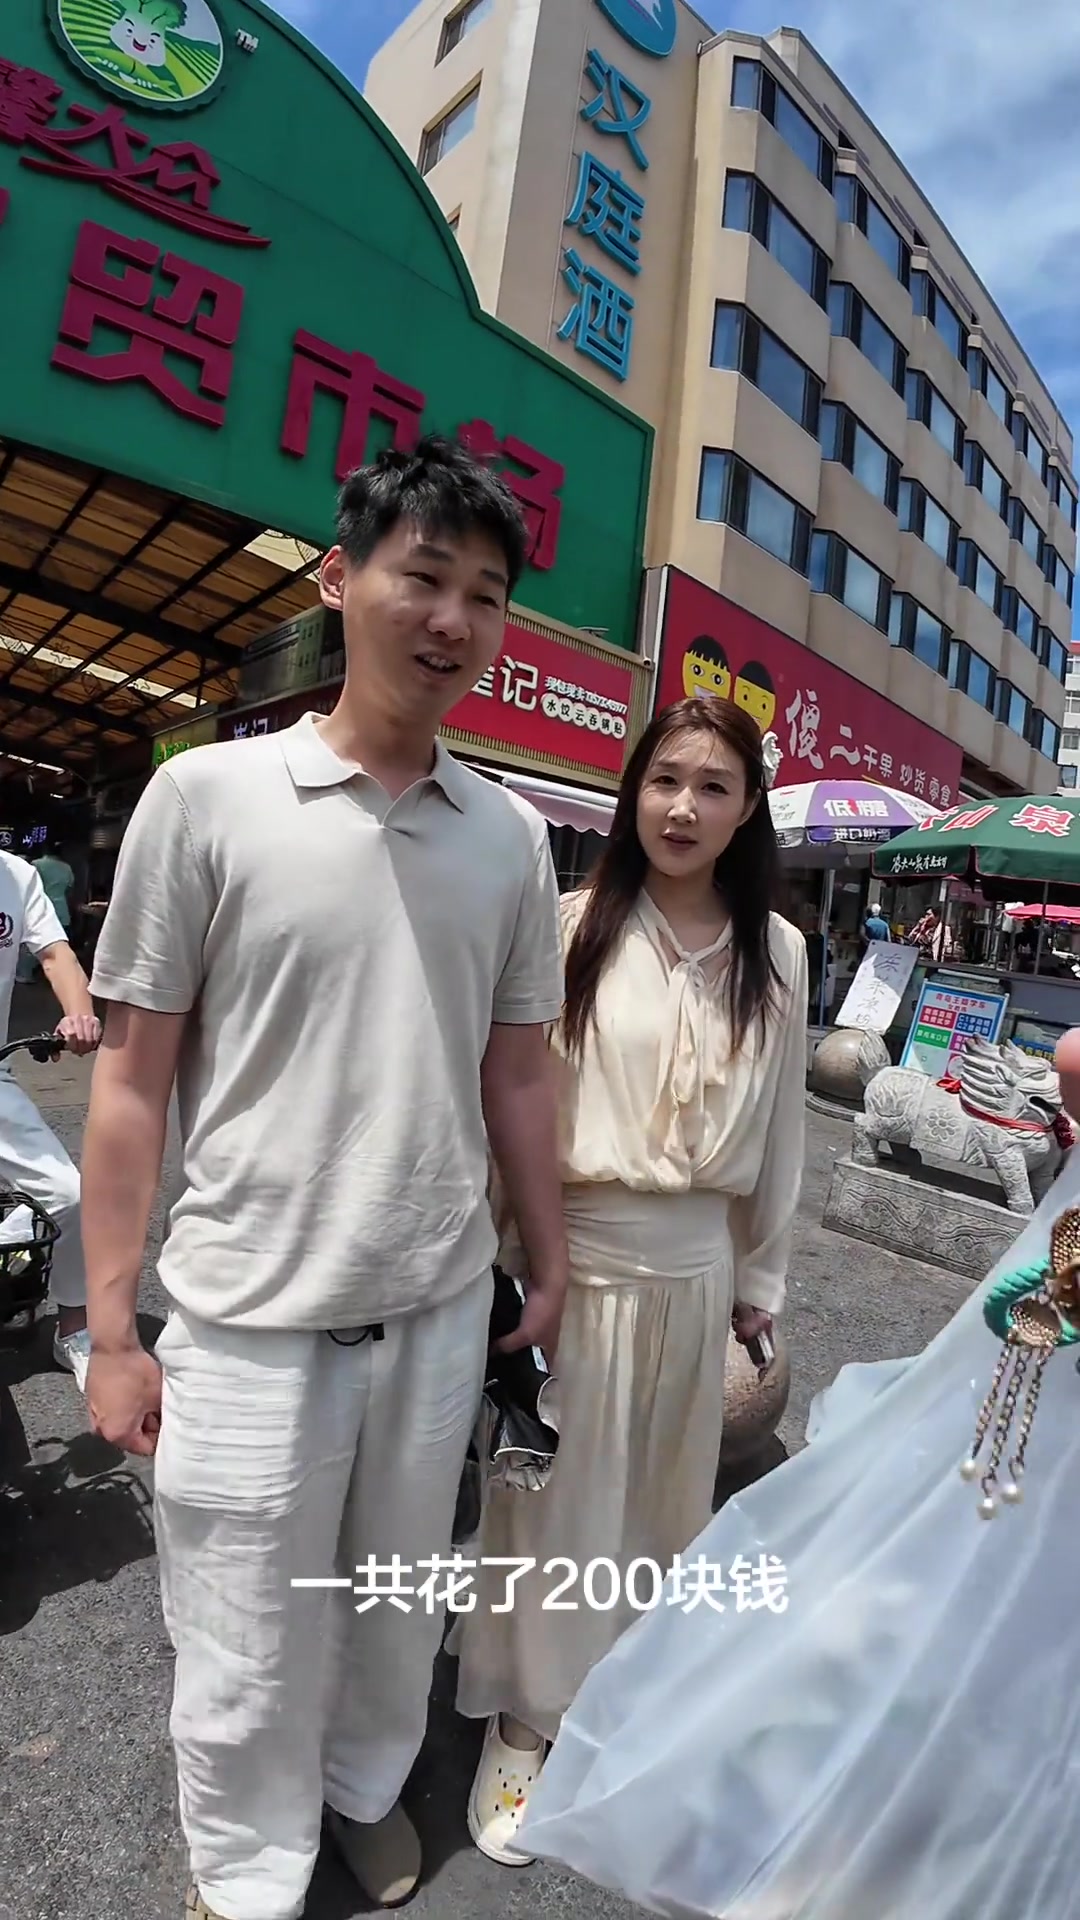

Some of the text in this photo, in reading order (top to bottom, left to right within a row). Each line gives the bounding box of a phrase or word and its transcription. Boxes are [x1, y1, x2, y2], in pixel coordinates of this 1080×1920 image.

[236, 28, 260, 53] TM
[556, 47, 651, 383] 汉庭酒
[0, 186, 565, 570] 贸市场
[862, 744, 893, 778] 干果
[900, 763, 926, 795] 炒货
[929, 776, 951, 807] 零食
[823, 799, 889, 817] 低糖
